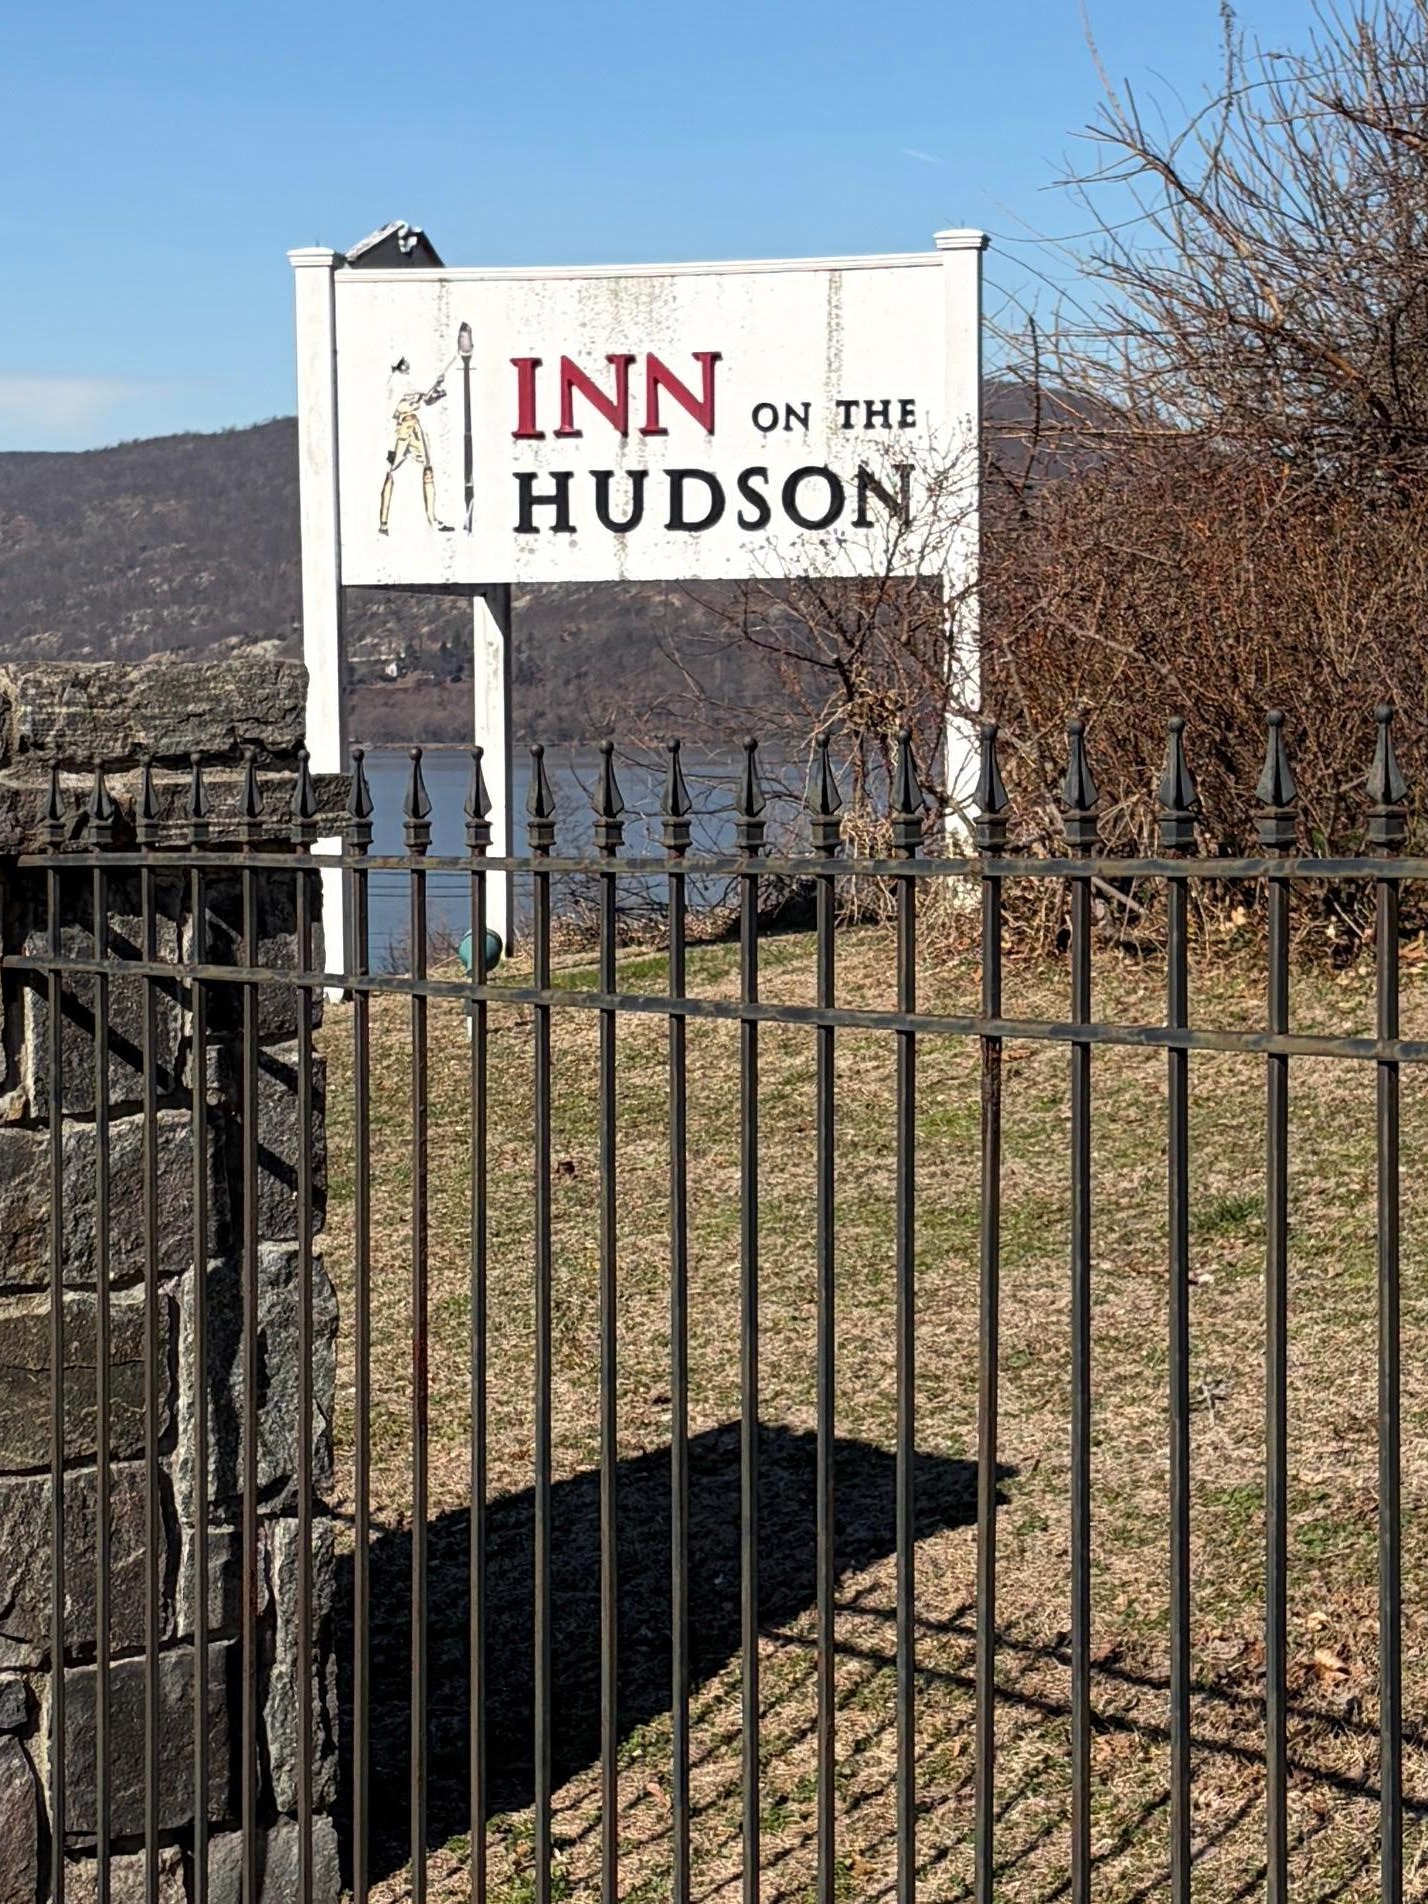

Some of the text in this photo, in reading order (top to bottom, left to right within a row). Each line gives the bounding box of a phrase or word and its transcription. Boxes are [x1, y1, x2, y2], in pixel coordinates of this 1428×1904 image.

[510, 352, 917, 440] INN ON THE
[512, 464, 916, 534] HUDSON
